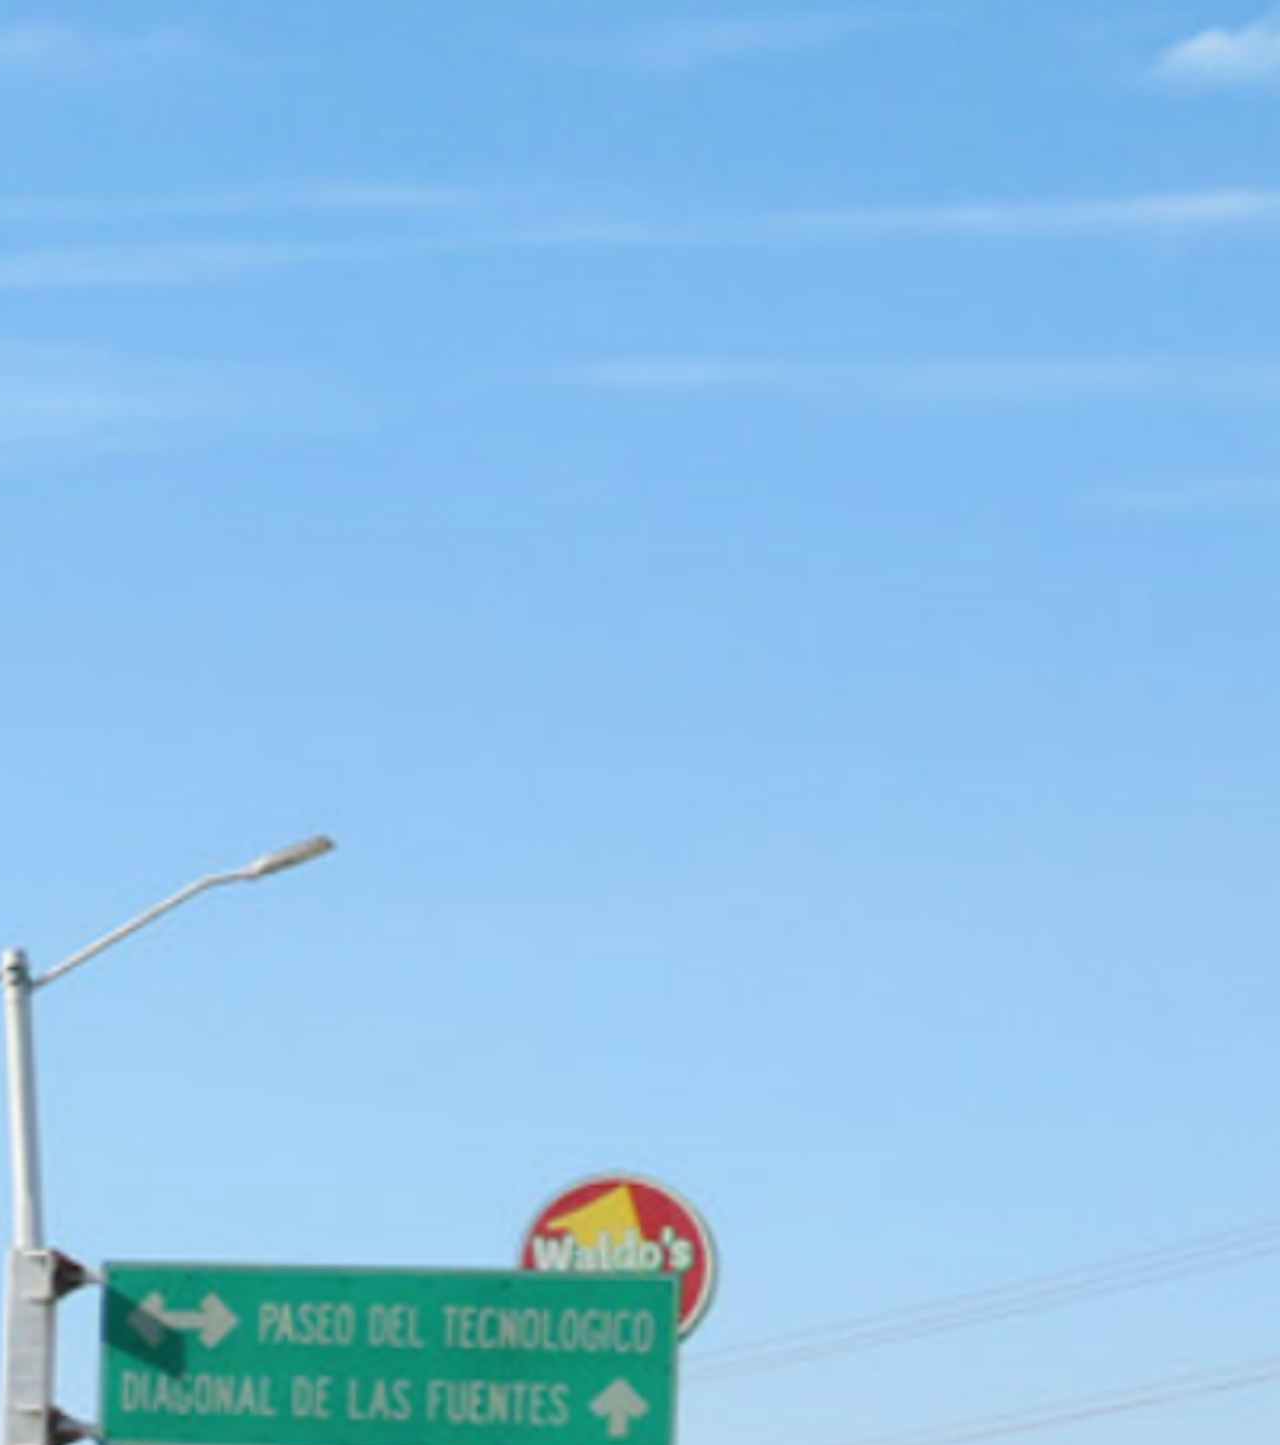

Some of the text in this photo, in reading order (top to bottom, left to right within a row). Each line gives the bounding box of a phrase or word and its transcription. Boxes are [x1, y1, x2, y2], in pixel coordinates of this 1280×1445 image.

[531, 1226, 695, 1272] Waldo's
[257, 1302, 656, 1353] PASEO DEL TECNOLOGICO
[120, 1370, 570, 1425] DIAGONAL DE LAS FUENTES
